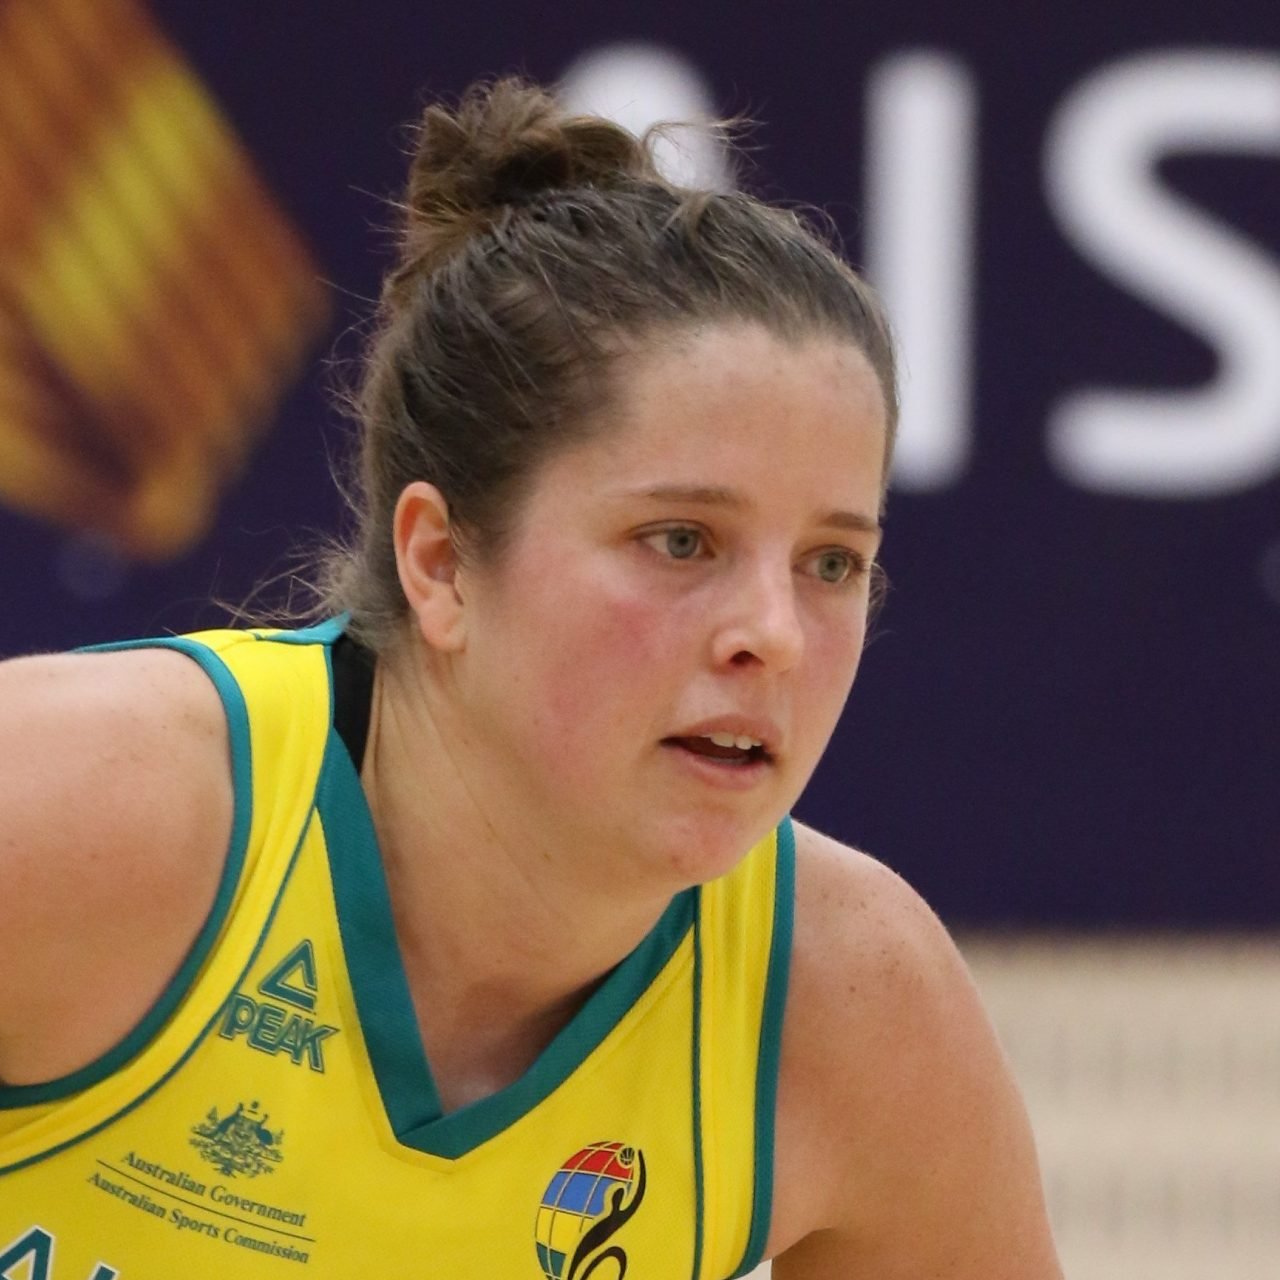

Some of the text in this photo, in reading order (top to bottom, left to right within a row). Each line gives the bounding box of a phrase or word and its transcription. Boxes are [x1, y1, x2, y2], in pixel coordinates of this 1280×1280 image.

[218, 992, 341, 1074] PEAK
[87, 1172, 310, 1265] Australian Sports Commission
[123, 1151, 306, 1227] Australian Government
